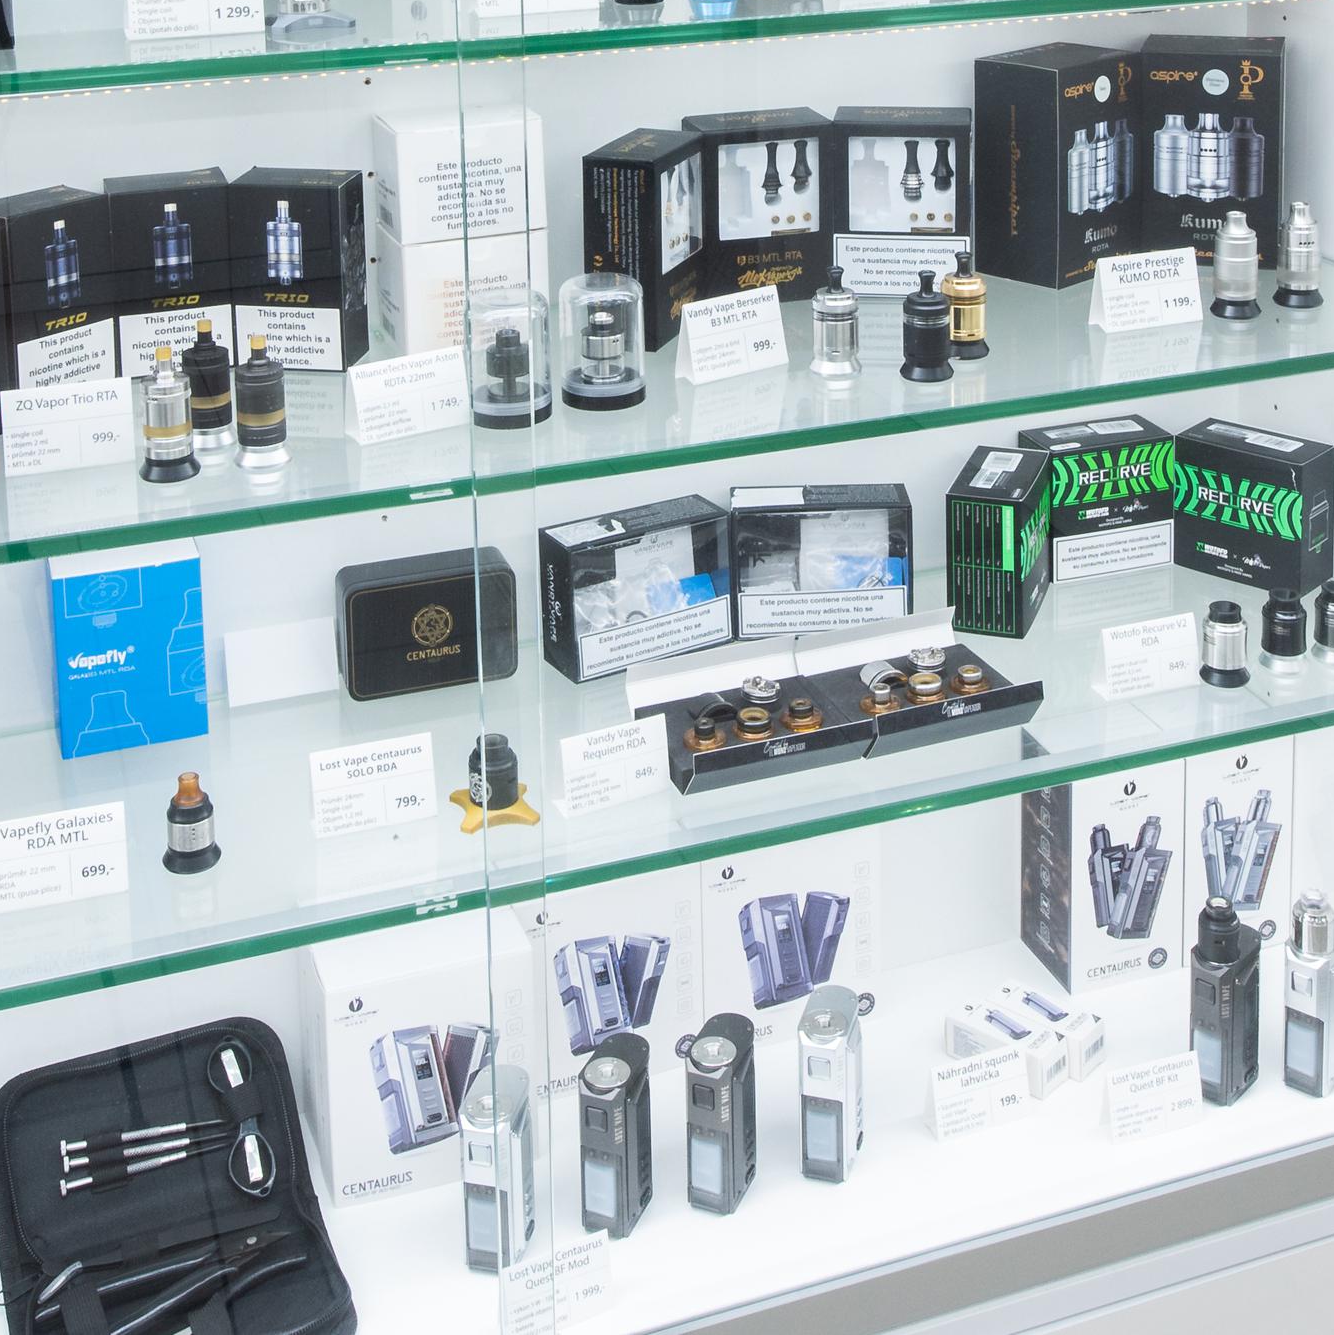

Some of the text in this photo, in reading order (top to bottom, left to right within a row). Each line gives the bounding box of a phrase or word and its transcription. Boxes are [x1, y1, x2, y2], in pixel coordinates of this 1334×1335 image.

[16, 391, 118, 411] ZQ Vapor Trio RTA
[92, 432, 120, 443] 999,-
[68, 649, 127, 670] Vapefly
[406, 643, 461, 663] CENTAURUS
[0, 812, 114, 839] Vapefly Galaxies
[27, 830, 88, 850] RDA MTL
[82, 864, 115, 878] 699,-
[342, 1171, 413, 1198] CENTAURUS
